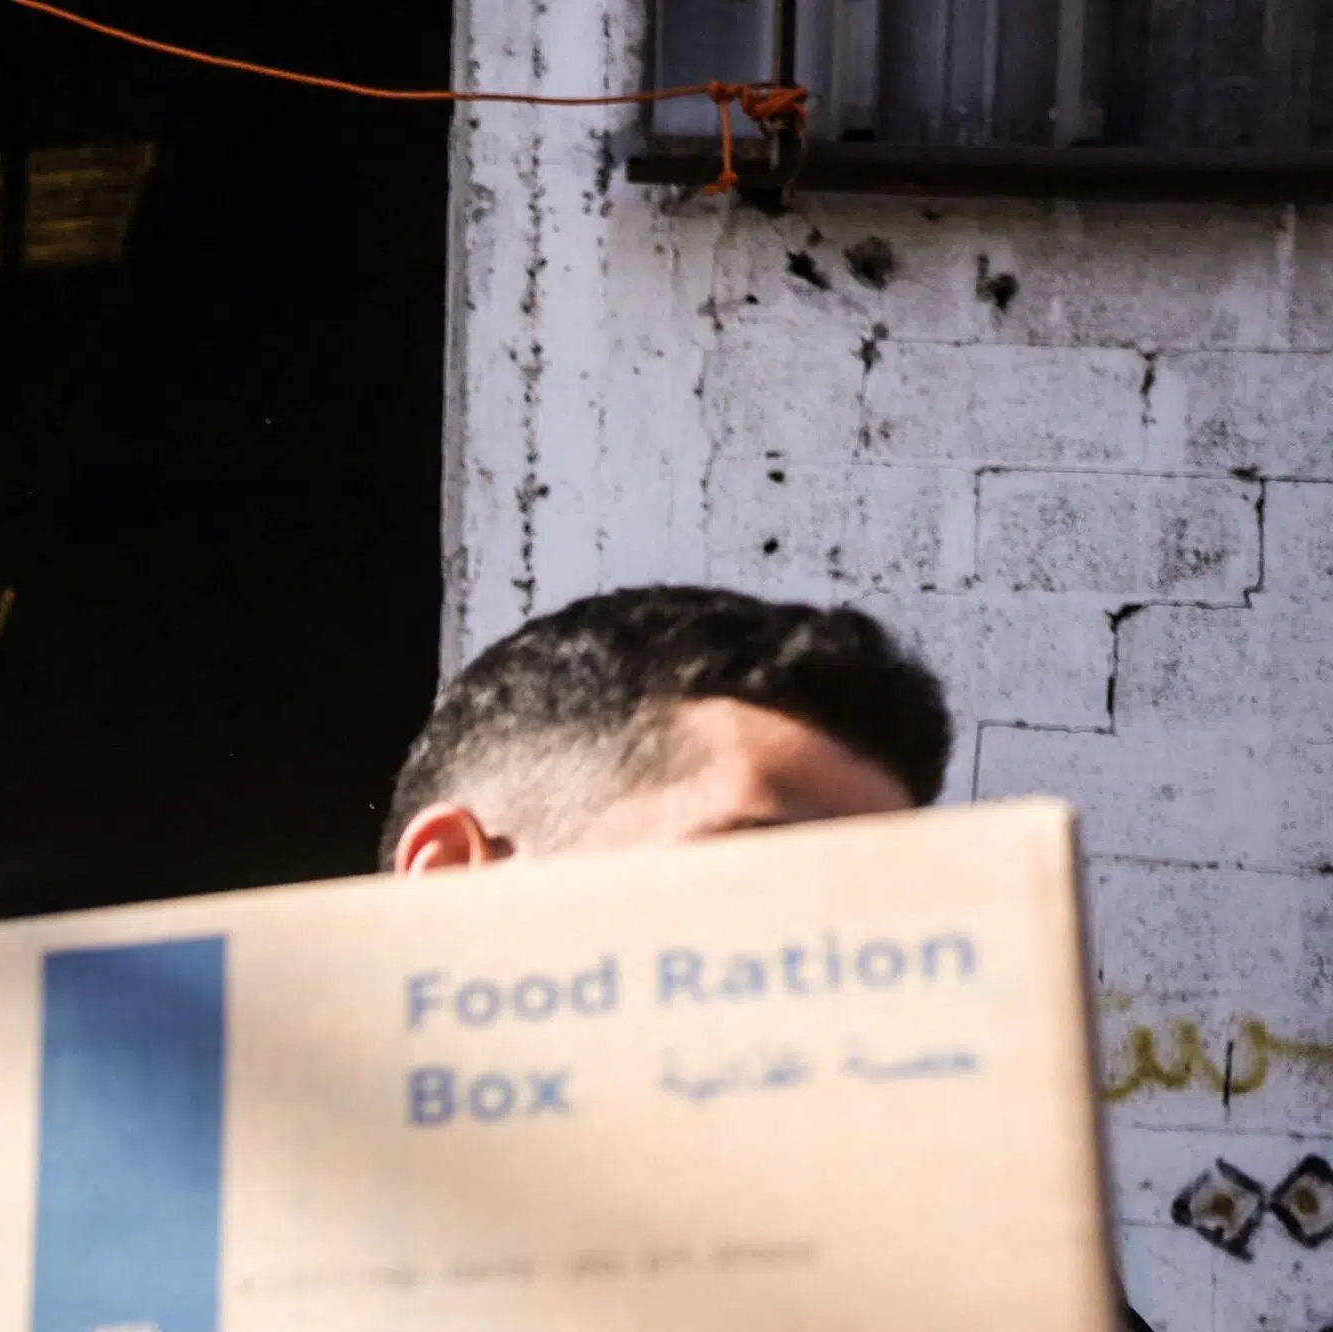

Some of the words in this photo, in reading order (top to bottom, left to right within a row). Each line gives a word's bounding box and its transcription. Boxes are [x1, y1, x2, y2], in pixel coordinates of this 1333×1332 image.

[405, 950, 620, 1033] Food
[656, 928, 978, 1005] Ration
[407, 1063, 571, 1128] Box
